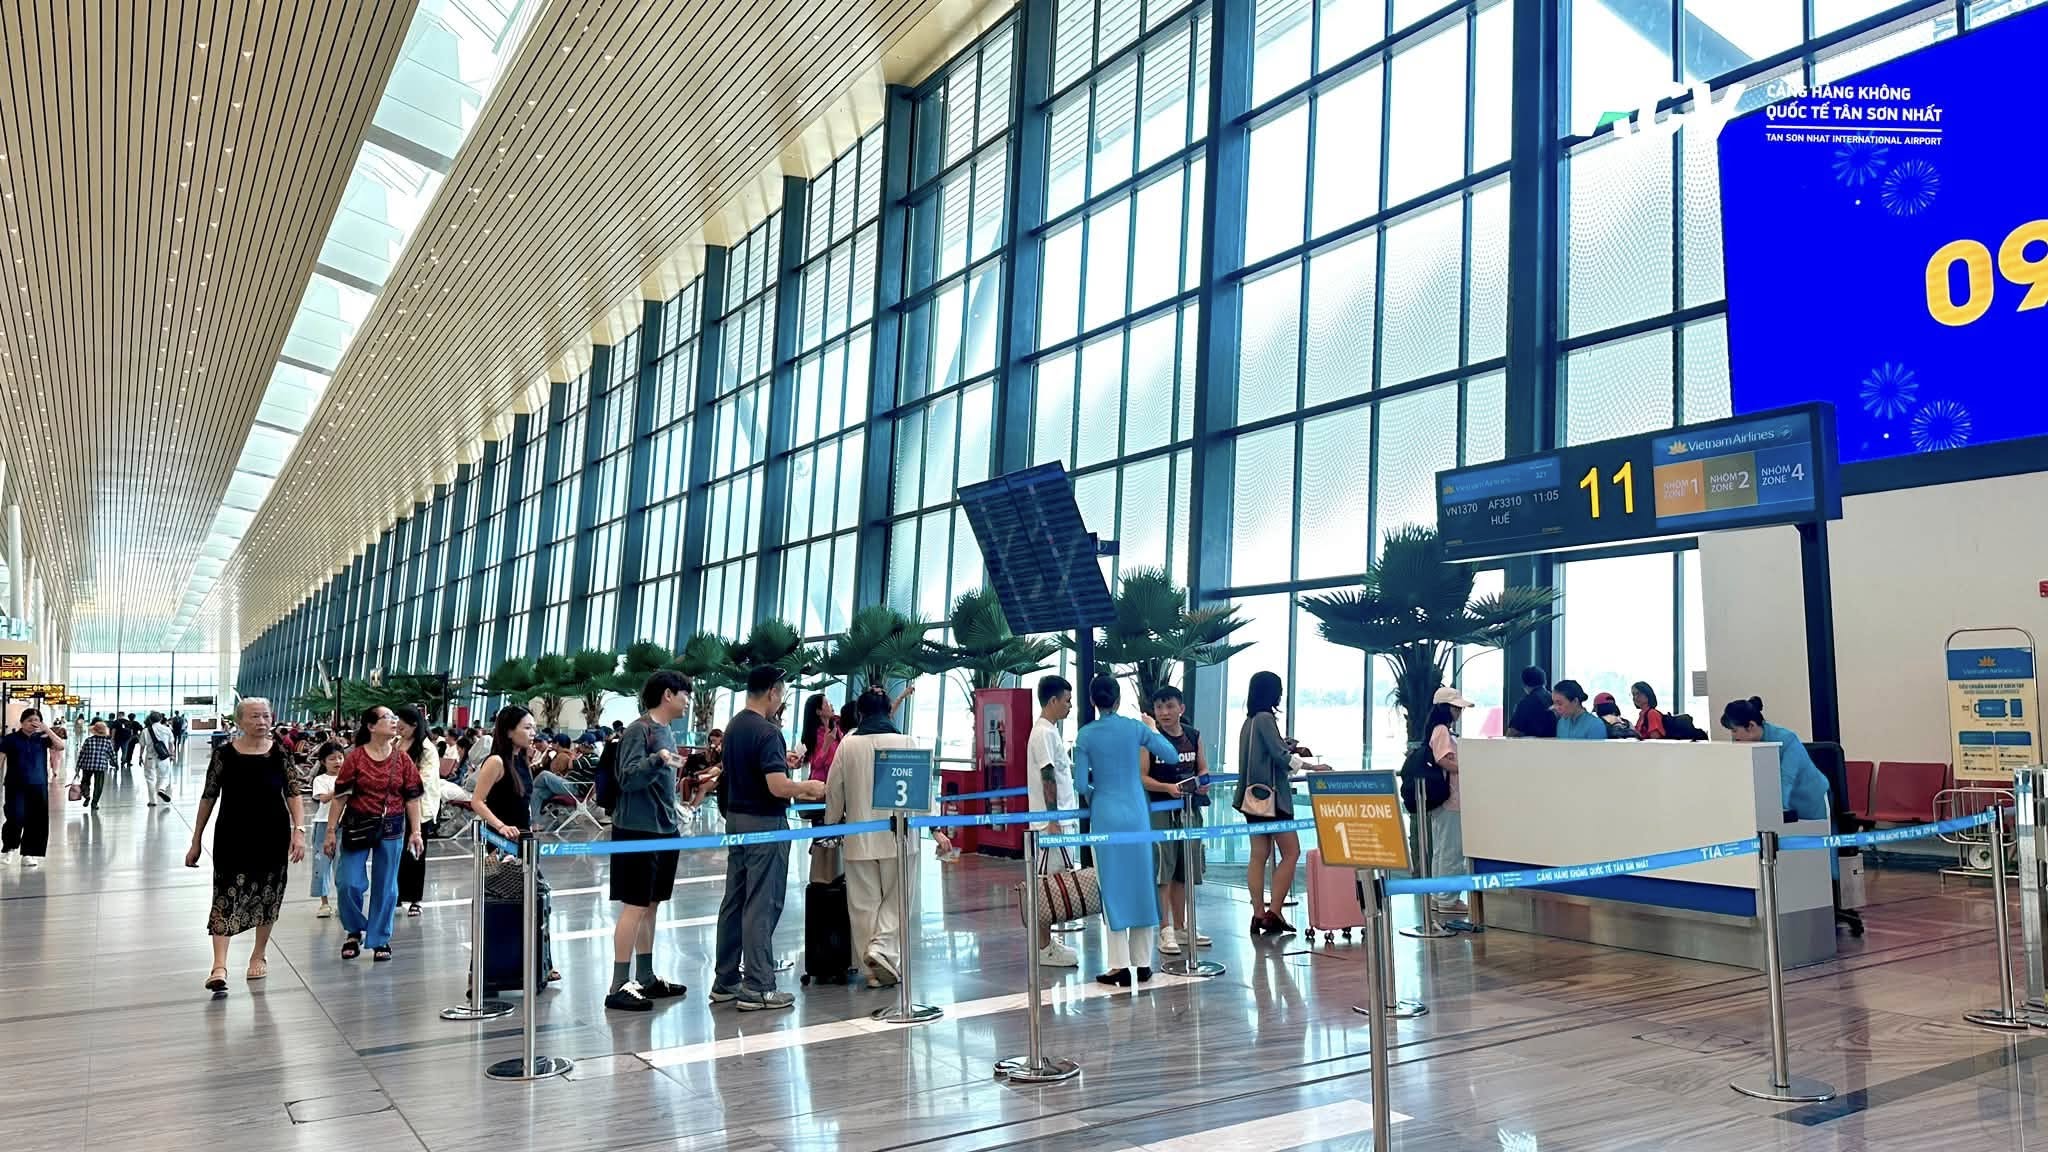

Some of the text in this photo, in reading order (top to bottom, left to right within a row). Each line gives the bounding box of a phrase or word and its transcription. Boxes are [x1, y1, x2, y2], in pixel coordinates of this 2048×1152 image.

[1925, 219, 2048, 326] 09
[1791, 463, 1805, 481] 4
[1691, 478, 1699, 495] 1
[1738, 471, 1750, 489] 2
[1762, 476, 1787, 486] ZONE
[1579, 461, 1634, 518] 11
[1711, 483, 1734, 493] ZONE
[1446, 489, 1560, 517] VN1370 AF3310 11:05
[891, 767, 913, 777] ZONE
[894, 780, 908, 807] 3
[1360, 804, 1393, 818] ZONE
[976, 815, 991, 825] TIA
[1973, 812, 1988, 826] TIA
[719, 833, 745, 846] ACV
[1163, 830, 1188, 841] TIA
[1334, 822, 1352, 859] 1
[1822, 835, 1841, 847] TIA
[540, 843, 560, 855] CV
[1700, 845, 1723, 860] TIA
[1471, 874, 1501, 889] TIA
